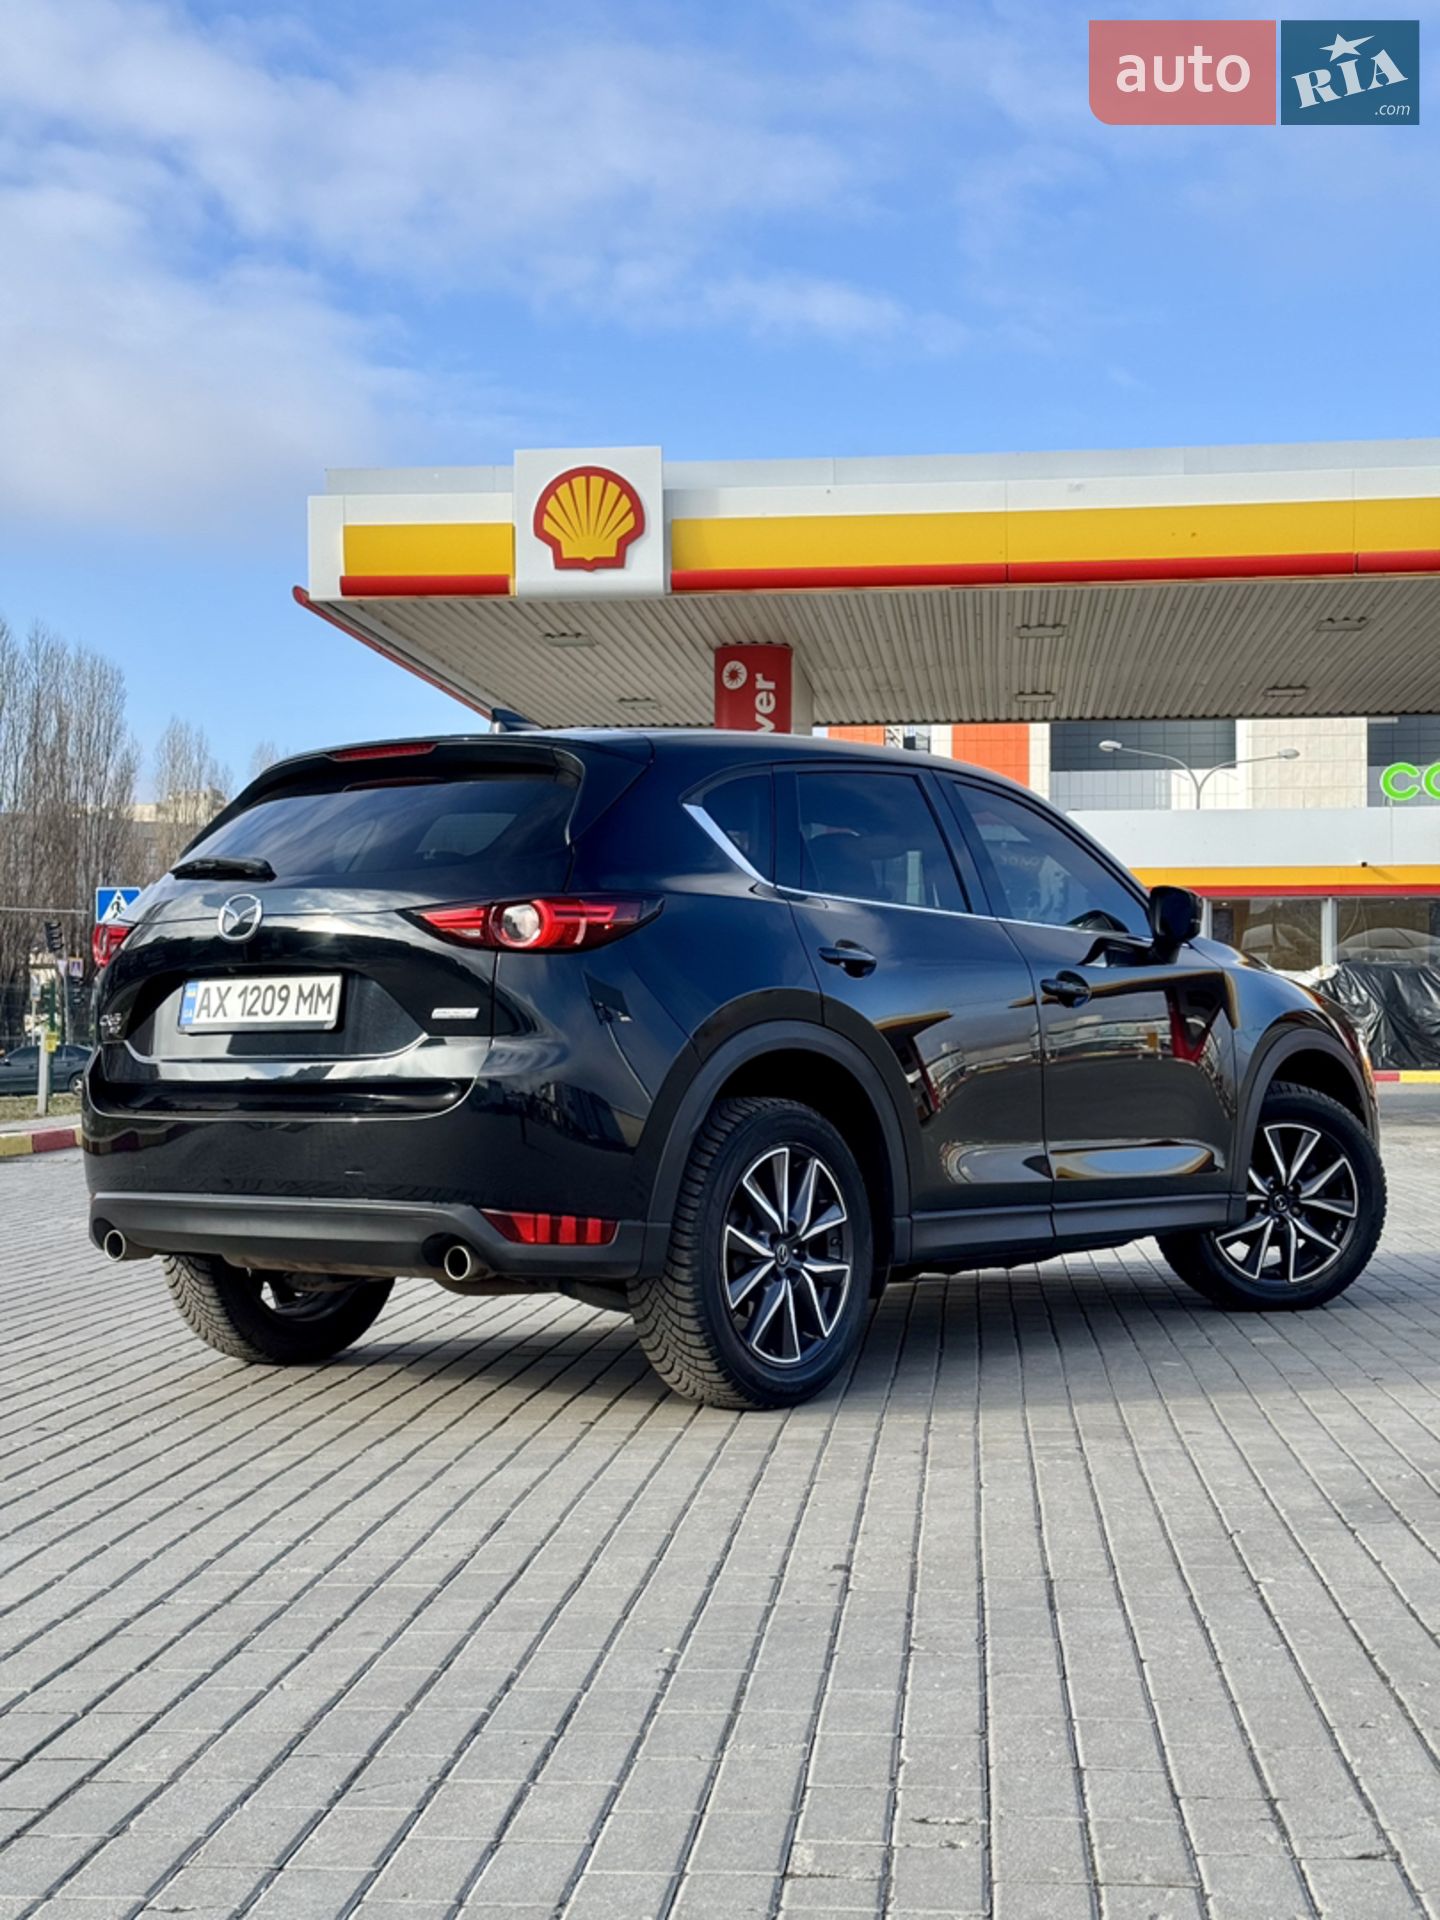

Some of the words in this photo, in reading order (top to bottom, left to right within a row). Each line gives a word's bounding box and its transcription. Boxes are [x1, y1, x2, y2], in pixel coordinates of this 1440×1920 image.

[195, 985, 232, 1019] AX
[237, 984, 291, 1017] 1209
[294, 982, 335, 1016] MM
